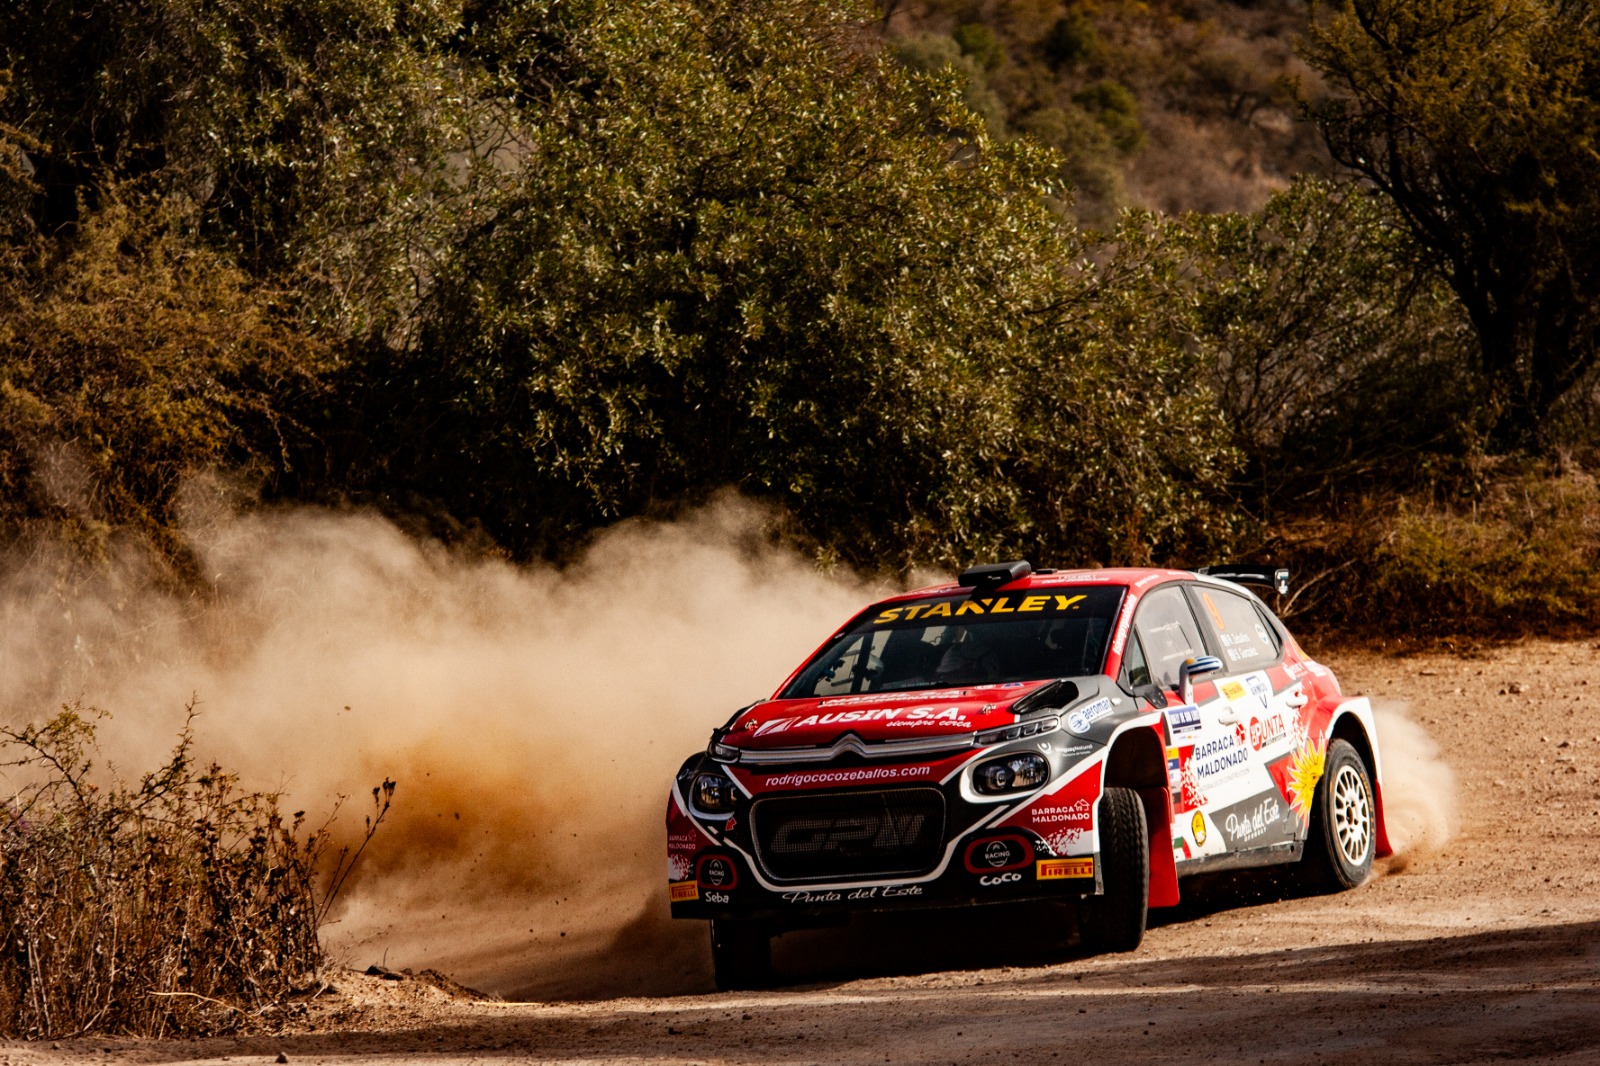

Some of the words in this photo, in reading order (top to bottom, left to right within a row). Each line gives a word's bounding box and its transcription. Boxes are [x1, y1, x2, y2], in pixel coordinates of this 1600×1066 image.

[873, 595, 1088, 624] STANLEY
[794, 708, 905, 728] AUSIN
[907, 707, 966, 720] S.A.
[1082, 700, 1109, 719] aeromar
[886, 719, 934, 728] siempre
[939, 718, 972, 728] cerca
[1195, 735, 1234, 760] BARRACA
[1196, 748, 1249, 780] MALDONADO
[765, 766, 931, 786] rodrigococozeballos.com
[1031, 806, 1074, 816] BARRACA
[1032, 813, 1090, 823] MALDONADO
[1225, 813, 1252, 842] Punta
[1252, 803, 1265, 831] del
[1264, 797, 1281, 825] Este
[985, 851, 1011, 860] RACING
[1041, 862, 1093, 877] PIRELLI
[671, 884, 697, 899] PIRELLI
[705, 891, 730, 903] Seba
[782, 890, 841, 903] Punta
[847, 886, 878, 900] del
[881, 885, 923, 897] Este
